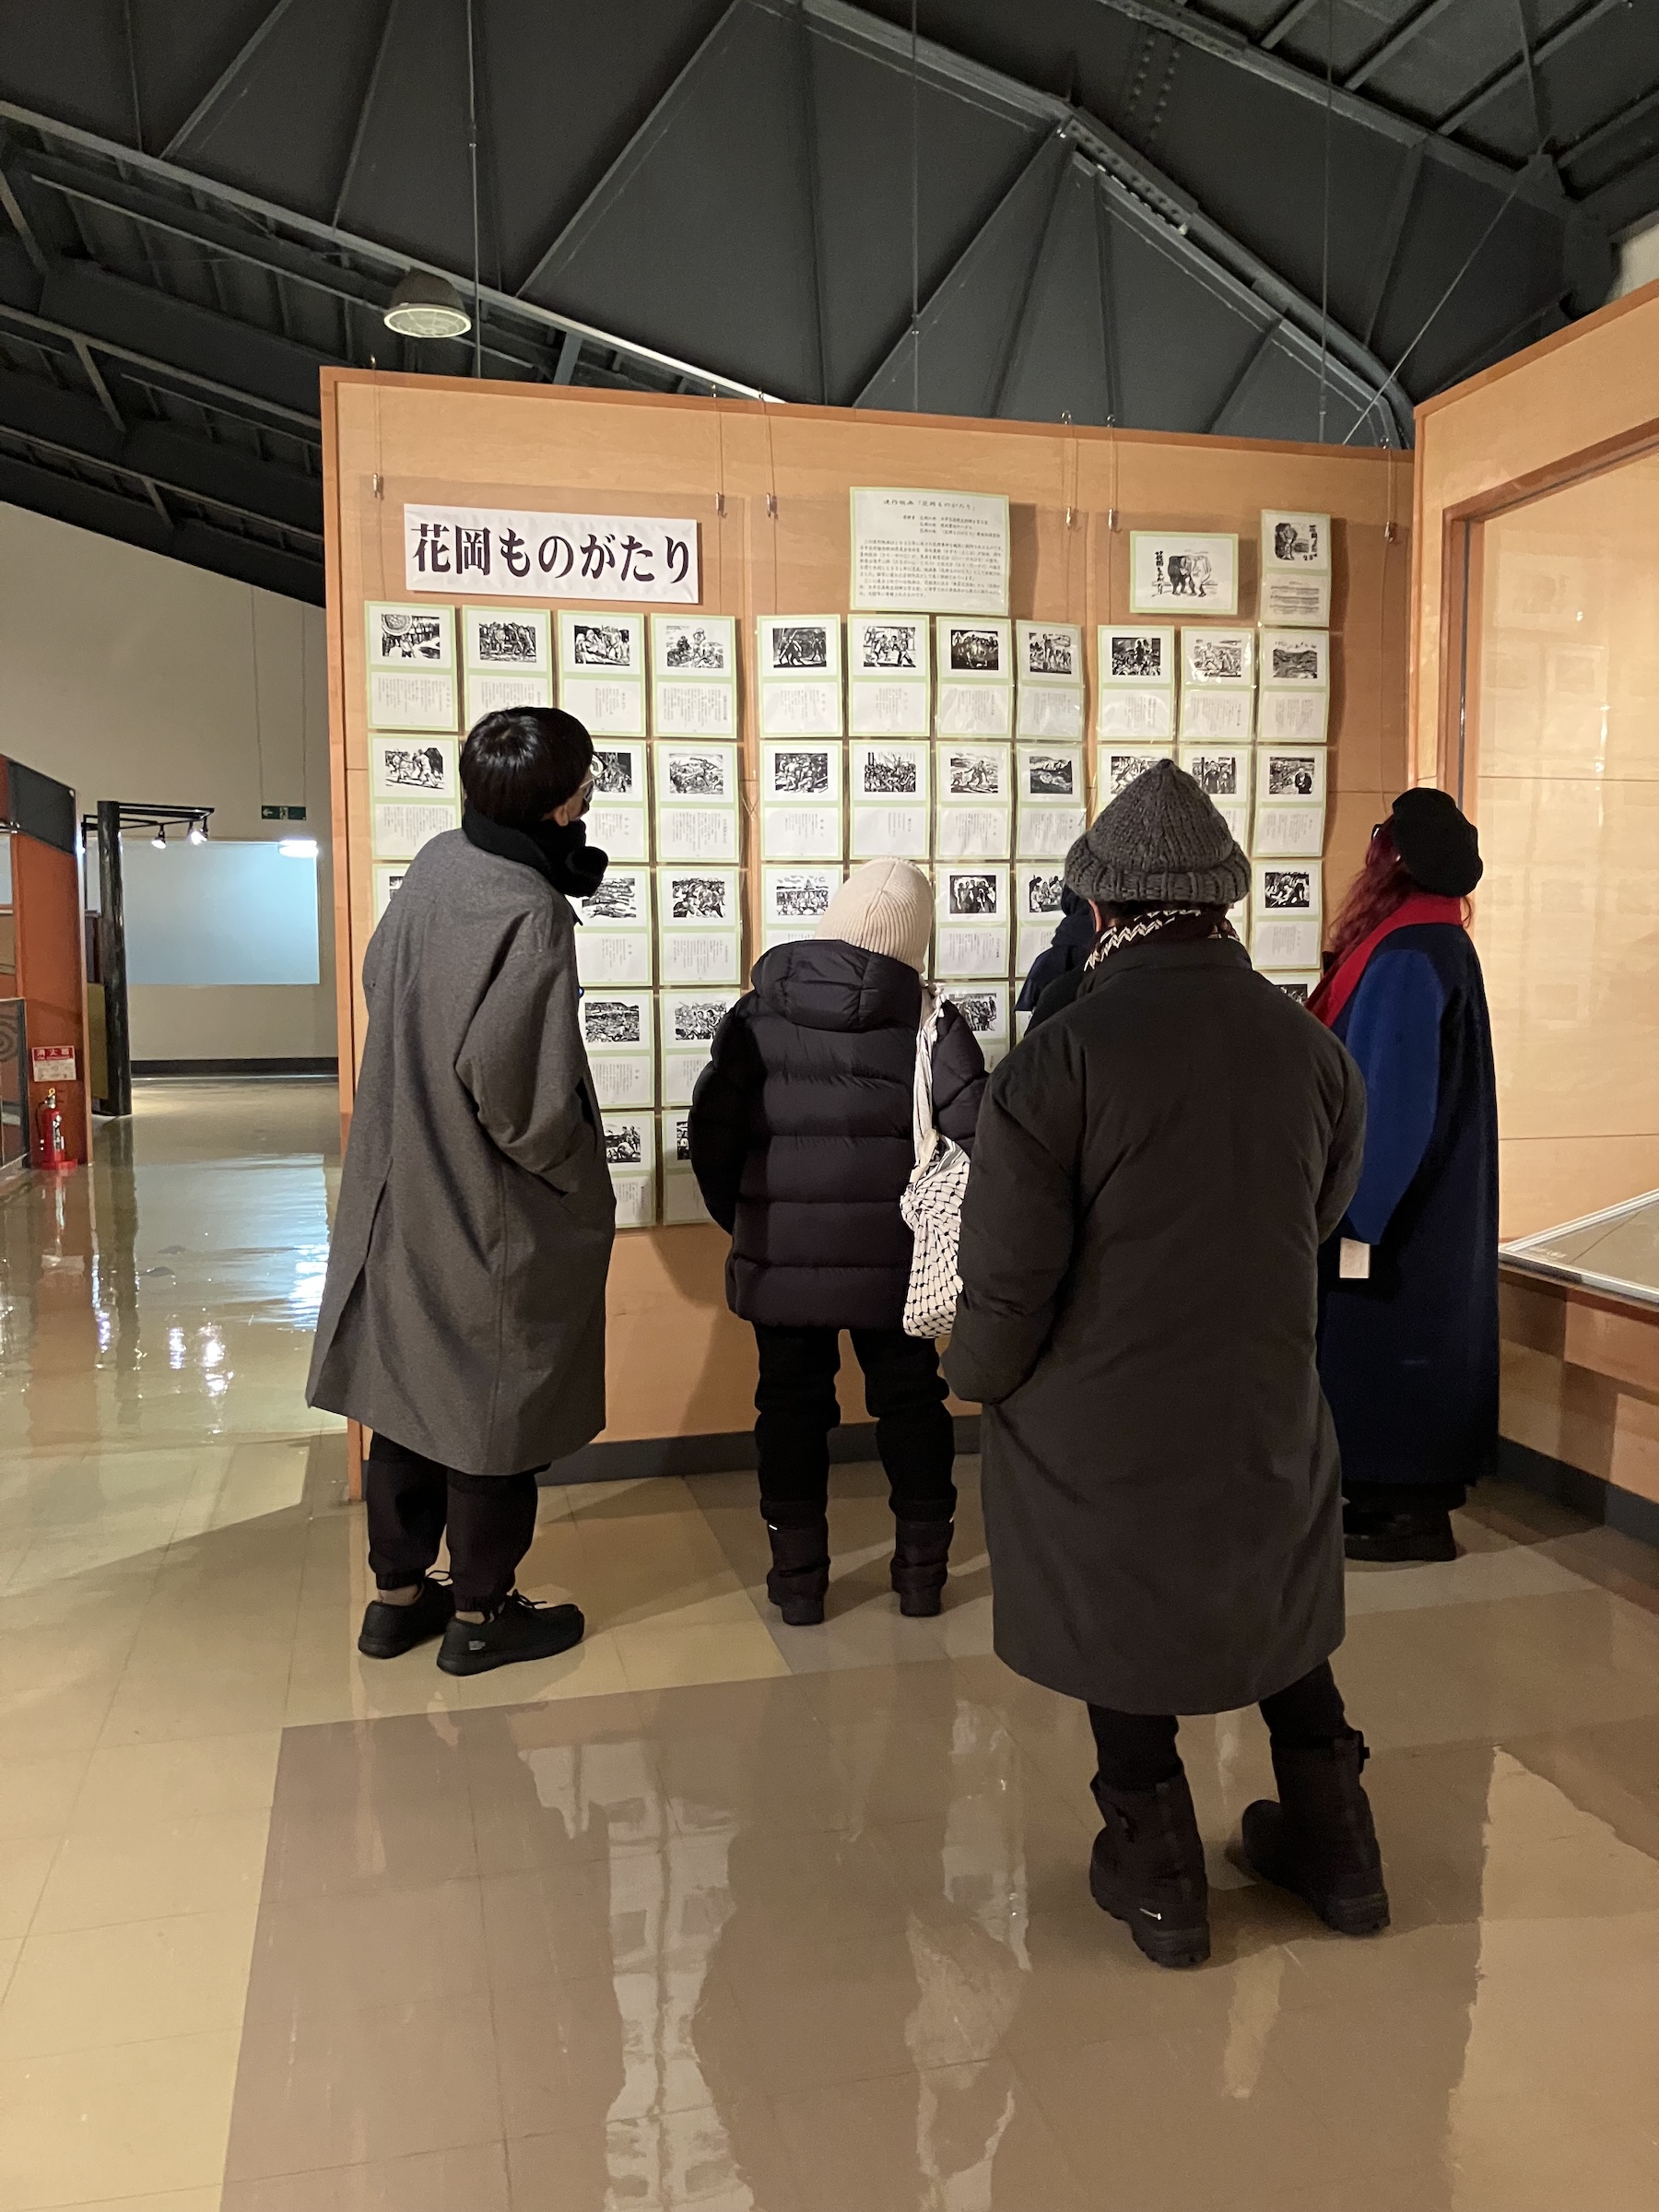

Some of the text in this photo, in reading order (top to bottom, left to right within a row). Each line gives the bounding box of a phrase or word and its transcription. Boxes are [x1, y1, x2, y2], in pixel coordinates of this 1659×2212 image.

[411, 523, 690, 584] 花岡ものがたり
